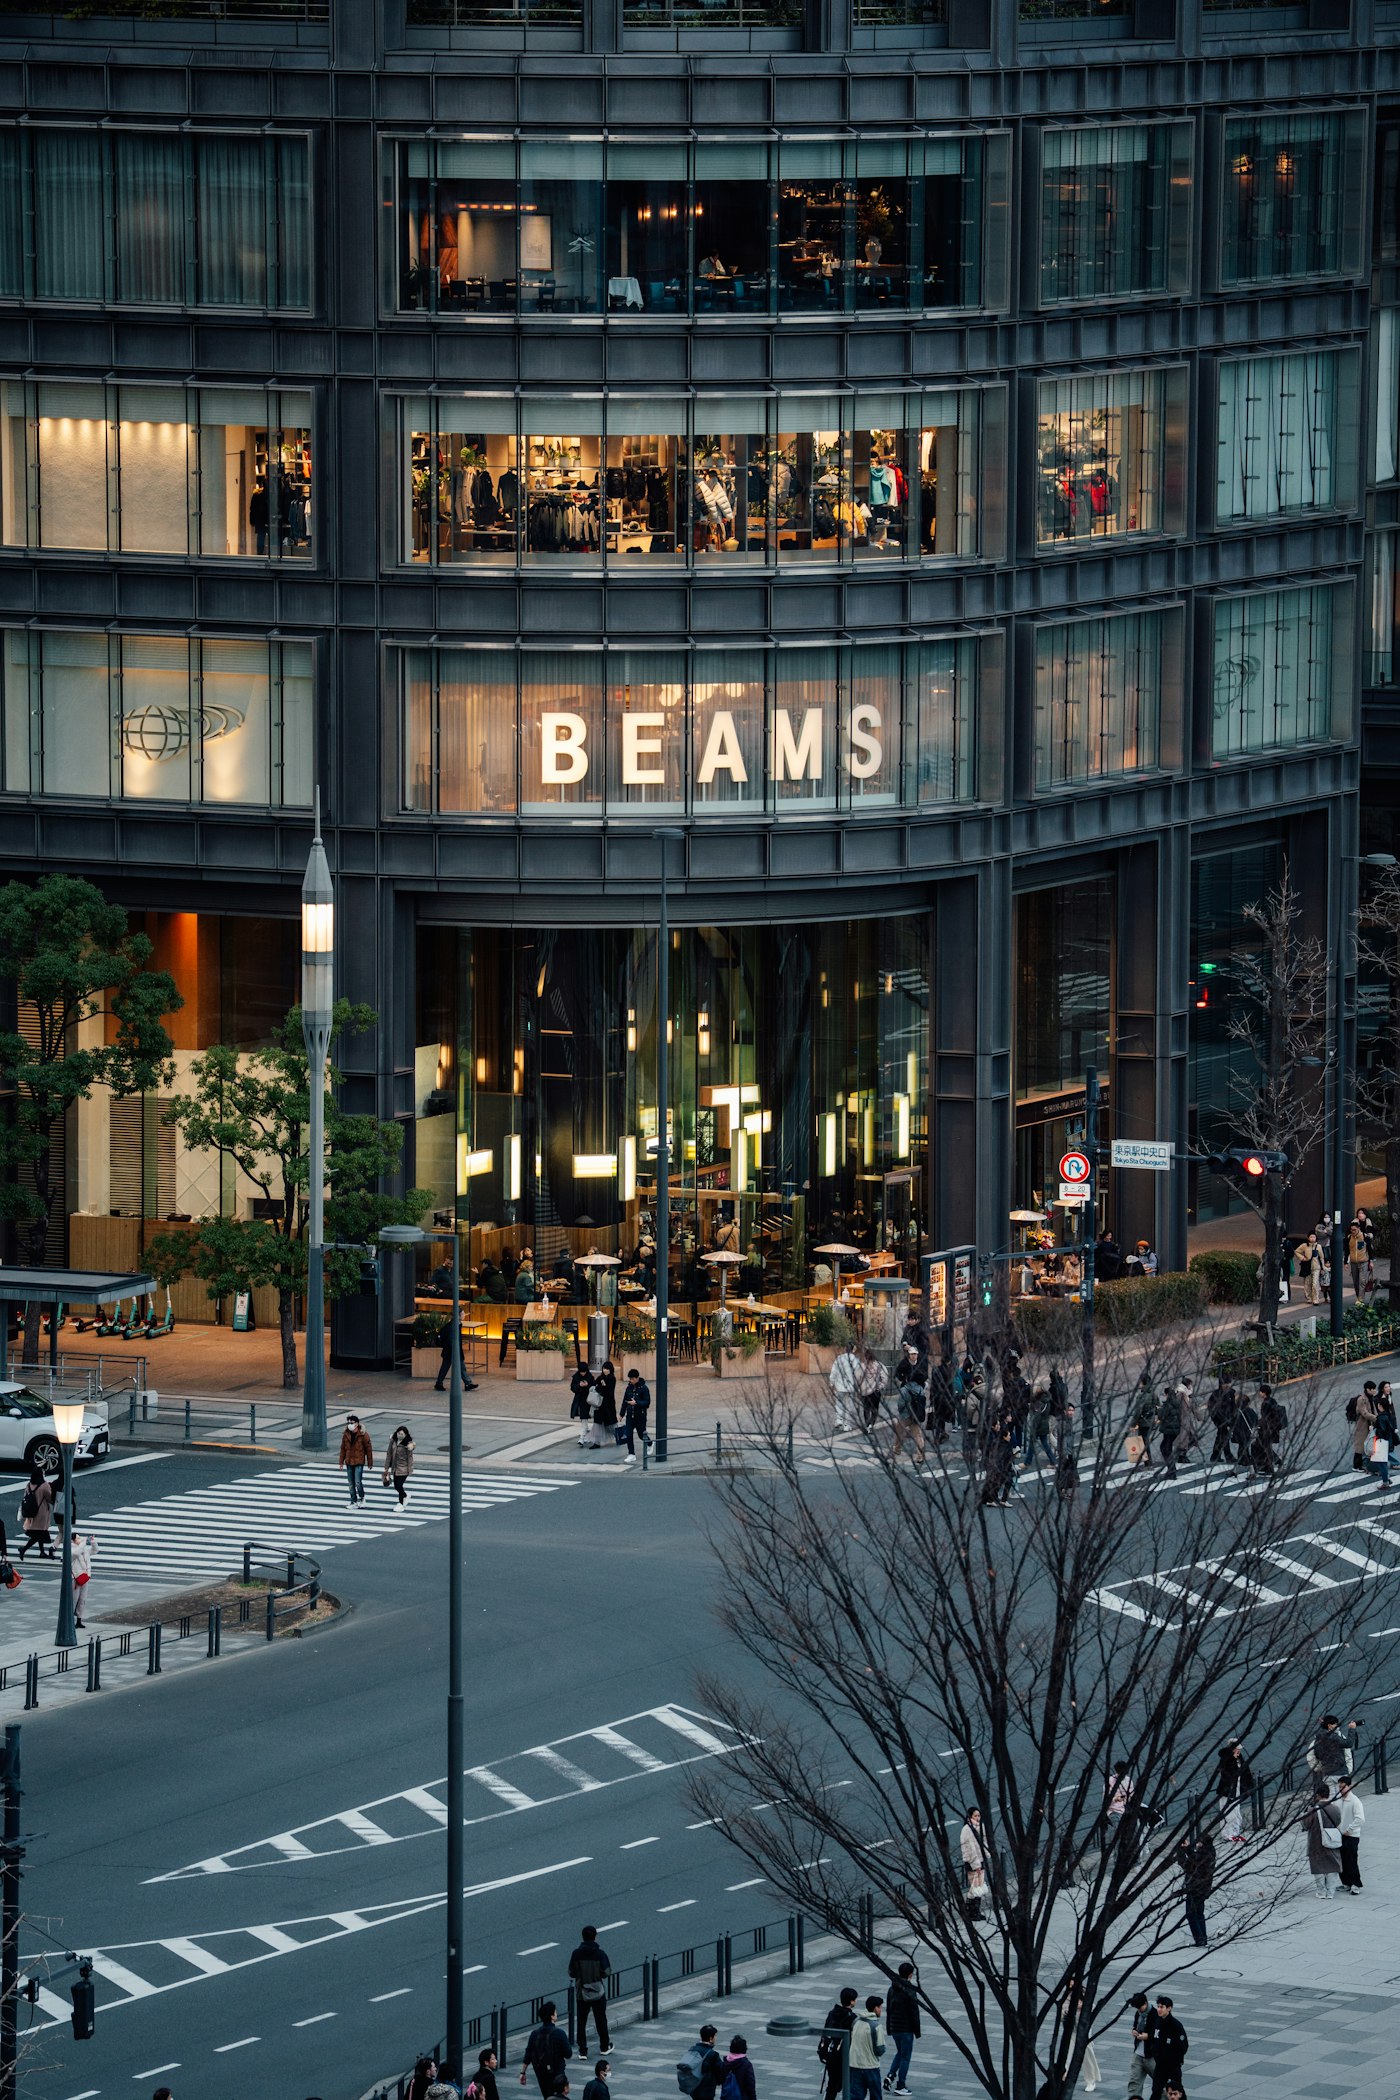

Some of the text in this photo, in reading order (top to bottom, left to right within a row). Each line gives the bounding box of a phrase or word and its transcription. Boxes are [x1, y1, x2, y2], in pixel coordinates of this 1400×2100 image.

[541, 703, 884, 785] BEAMS
[1115, 1145, 1167, 1158] 東京駅中央口
[1114, 1156, 1129, 1165] Tokyo
[1140, 1159, 1168, 1167] Chuoguchi
